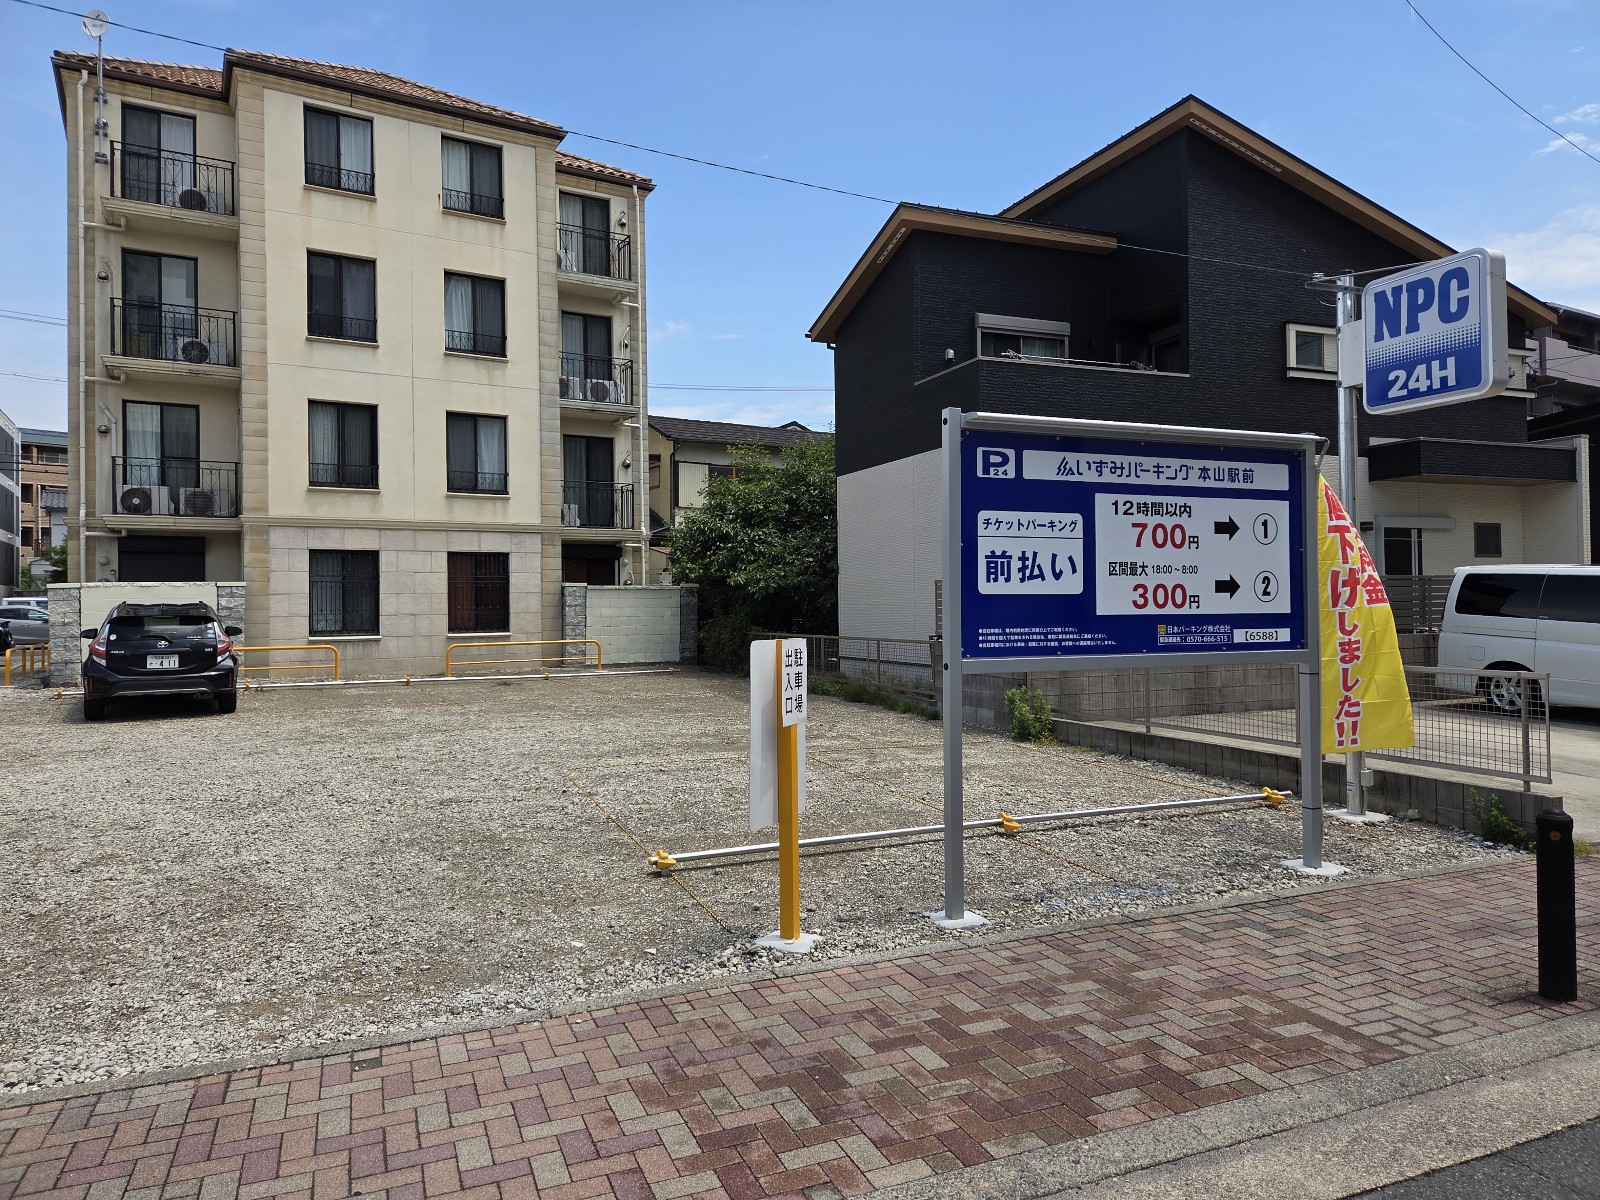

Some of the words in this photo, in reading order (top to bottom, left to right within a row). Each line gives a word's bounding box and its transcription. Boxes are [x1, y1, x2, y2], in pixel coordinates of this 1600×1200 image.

[1374, 266, 1470, 343] NPC
[1387, 356, 1457, 398] 24H
[981, 449, 1010, 476] P
[992, 468, 1009, 477] 24
[1111, 500, 1192, 518] 12時間以内
[982, 517, 1078, 533] チケットパーキング
[1131, 522, 1200, 550] 700円
[984, 550, 1078, 584] 前払い
[1108, 561, 1149, 577] 区間最大
[1131, 583, 1200, 610] 300円
[1167, 624, 1232, 634] 日本パーキング株式会社
[784, 648, 793, 716] 出入口
[794, 647, 804, 714] 駐車場
